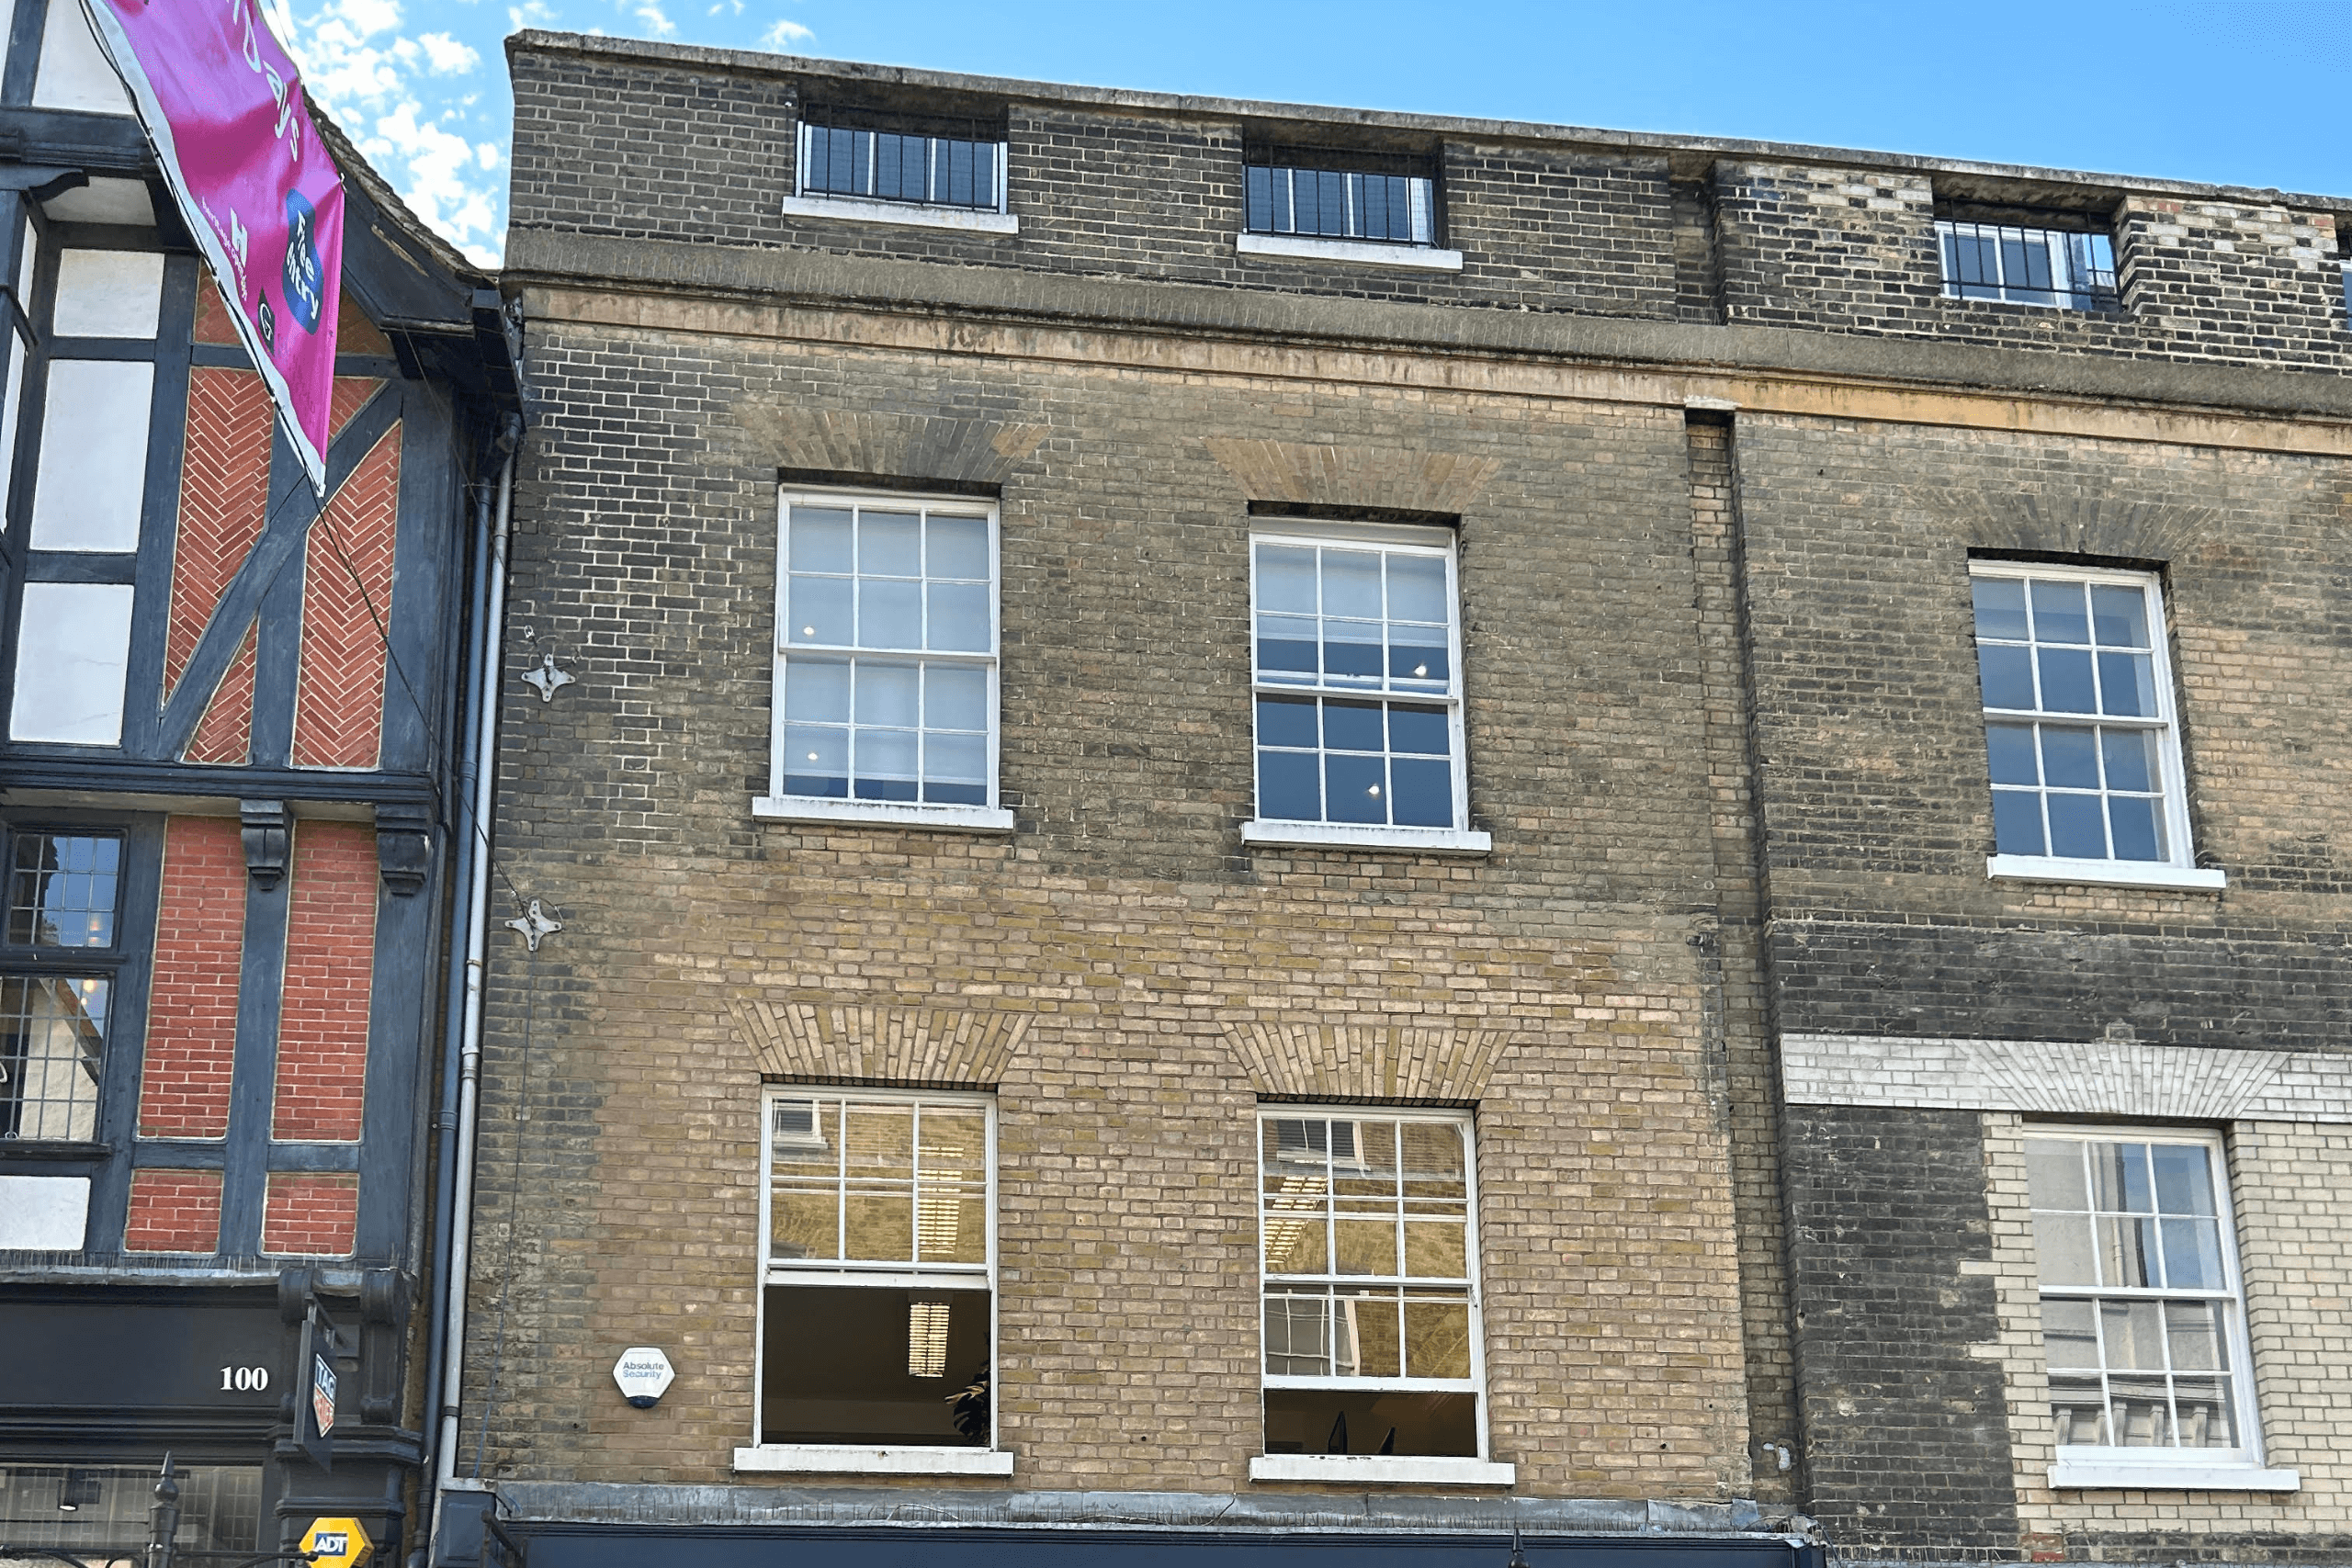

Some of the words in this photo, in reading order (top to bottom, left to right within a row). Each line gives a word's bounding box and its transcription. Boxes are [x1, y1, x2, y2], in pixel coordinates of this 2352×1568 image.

[297, 209, 315, 282] Free
[286, 241, 320, 321] entry
[220, 1365, 269, 1392] 100
[623, 1361, 664, 1370] Absolute
[623, 1369, 662, 1380] Security
[317, 1359, 335, 1401] TAG
[313, 1536, 348, 1552] ADT
